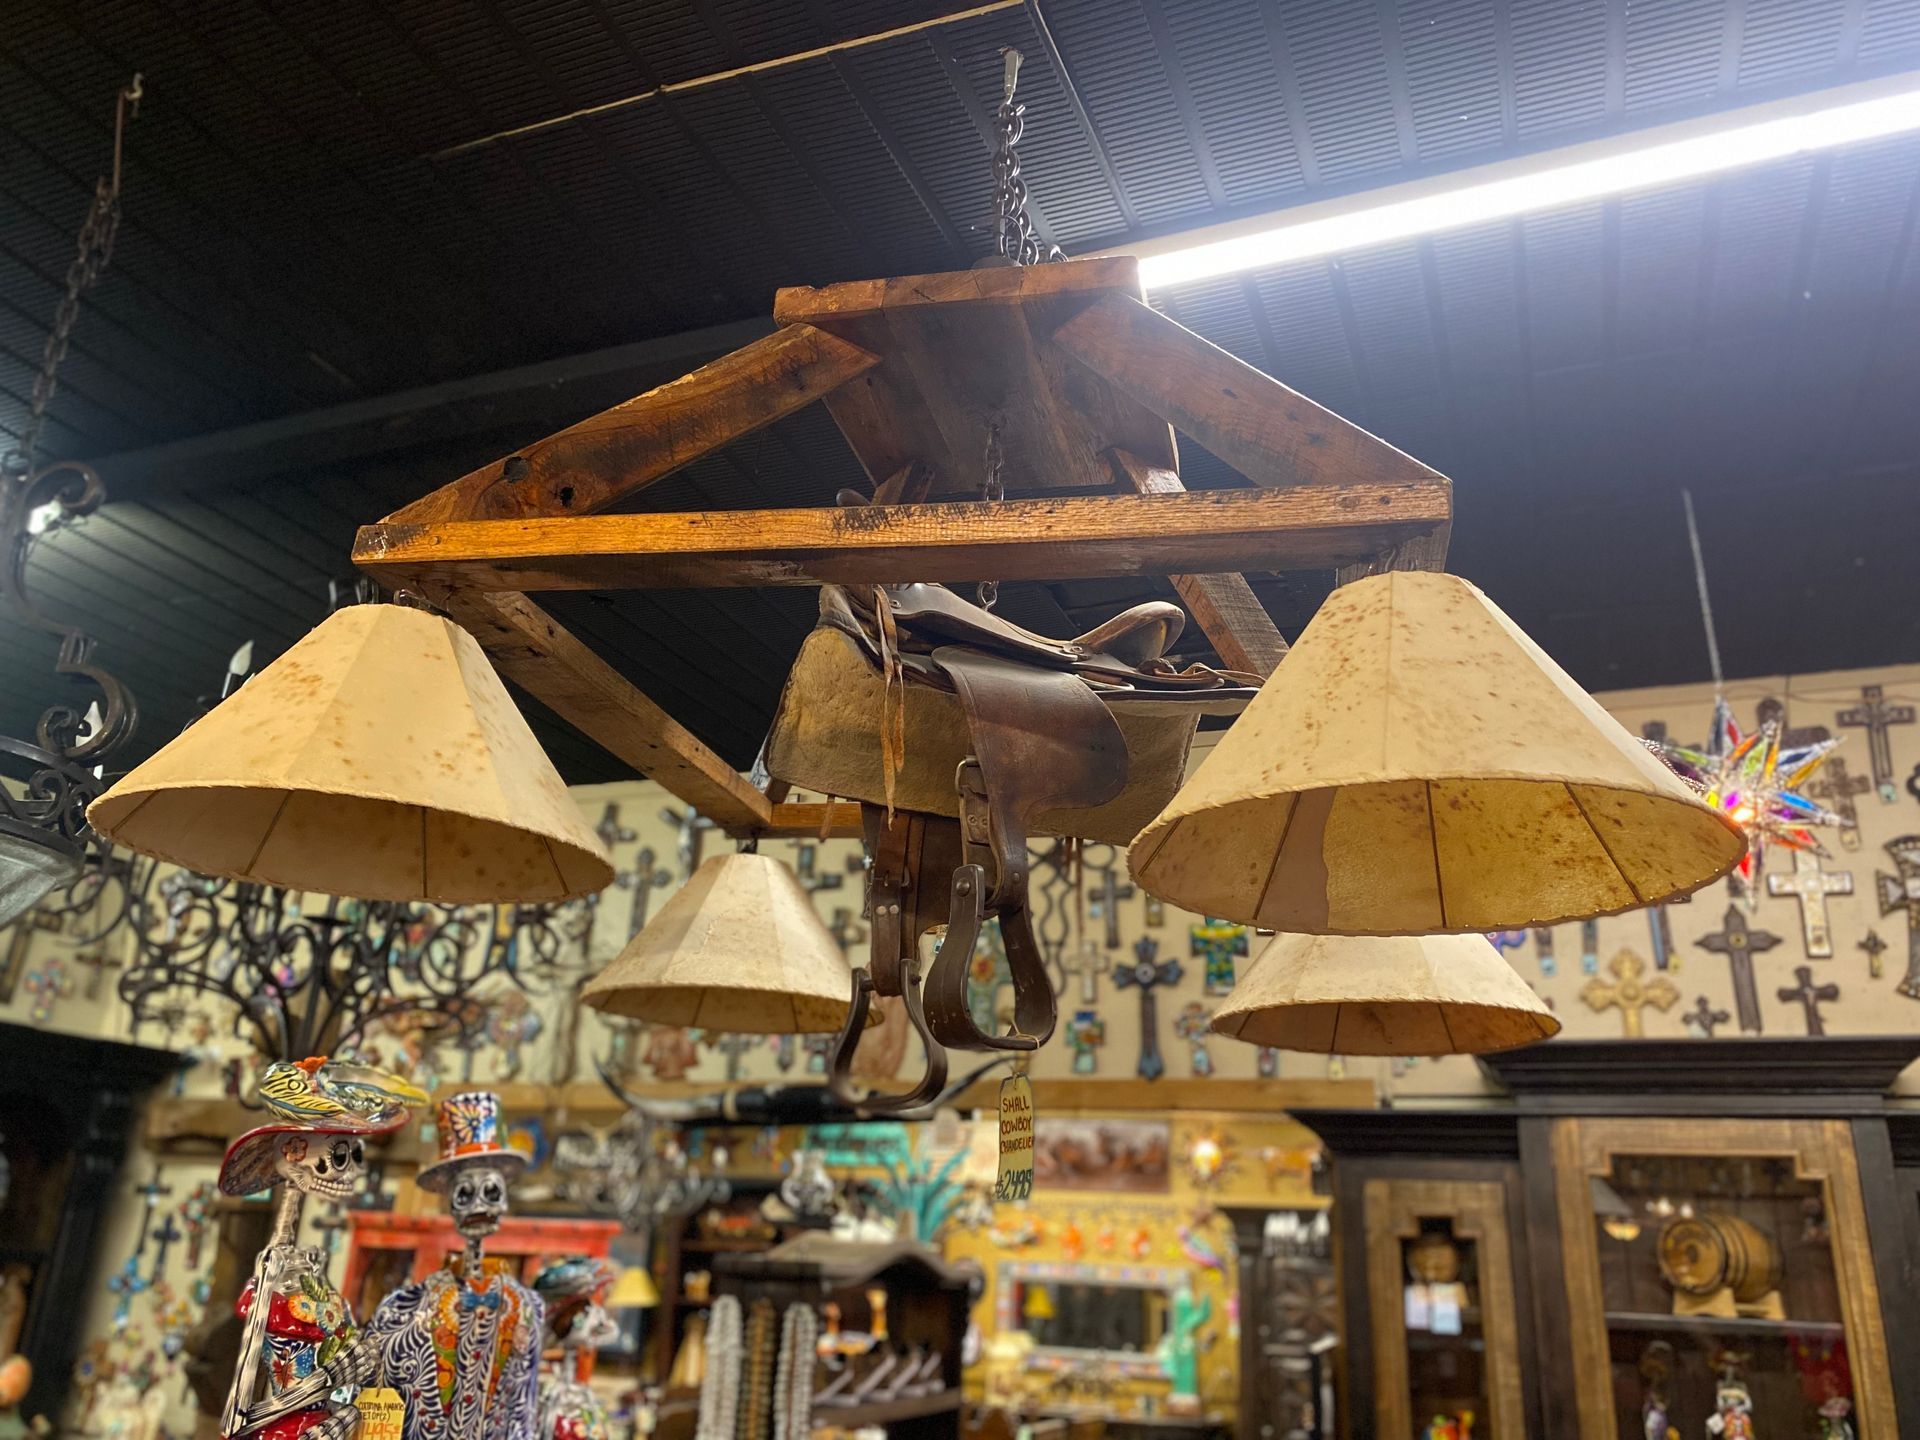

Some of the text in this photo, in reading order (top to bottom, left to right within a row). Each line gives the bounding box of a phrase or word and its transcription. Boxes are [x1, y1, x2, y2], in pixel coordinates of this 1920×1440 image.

[1002, 1096, 1030, 1113] SMALL
[1001, 1117, 1032, 1136] COWBOY
[995, 1168, 1033, 1200] $2495
